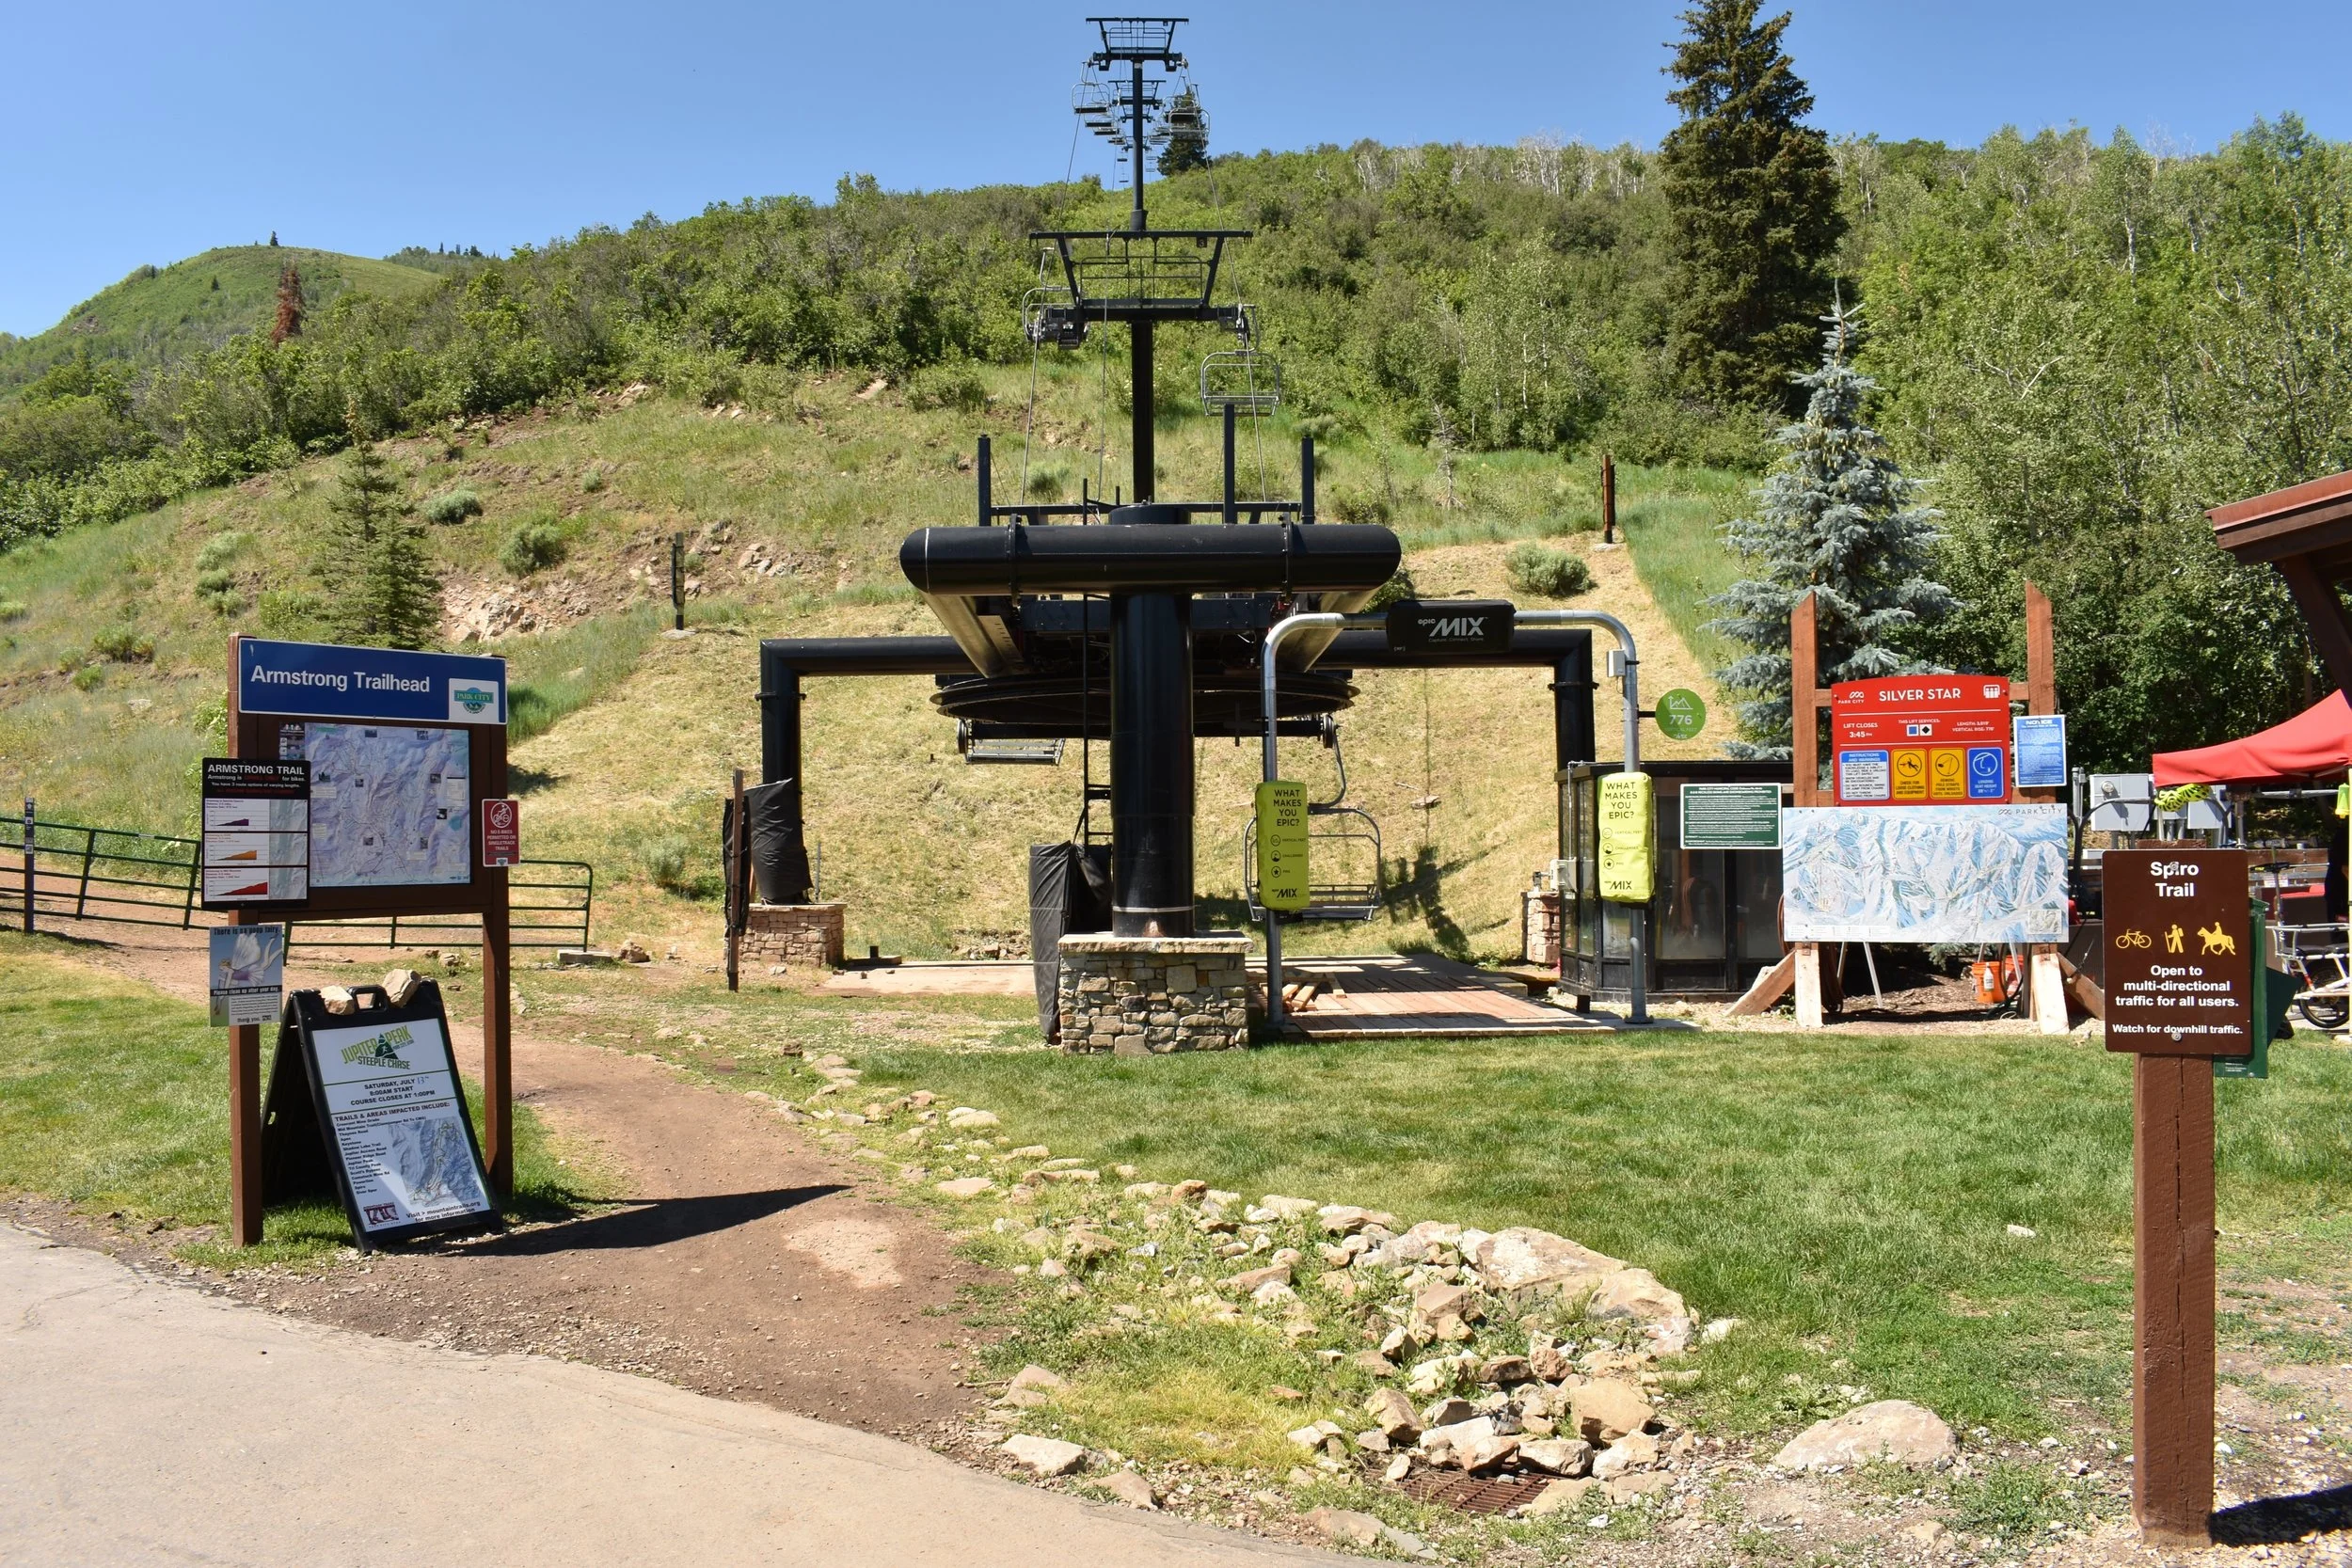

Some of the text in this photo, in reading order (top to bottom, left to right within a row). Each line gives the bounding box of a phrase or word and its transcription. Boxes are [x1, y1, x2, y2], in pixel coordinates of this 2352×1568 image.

[1429, 617, 1484, 637] MIX
[251, 665, 430, 692] Armstrong Trailhead
[1879, 688, 1961, 702] SILVER STAR
[1669, 715, 1692, 725] 776
[208, 765, 273, 774] ARMSTRONG
[1610, 880, 1632, 890] MIX
[2155, 882, 2194, 896] Trail
[1277, 888, 1297, 898] MIX
[2151, 965, 2202, 978] Open to
[2124, 980, 2230, 991] multi-directional
[2116, 996, 2239, 1006] traffic for all users.
[2112, 1024, 2243, 1034] Watch for downhill traffic.
[342, 1037, 377, 1064] JUPITER
[385, 1025, 412, 1044] PEAK
[358, 1056, 410, 1069] STEEPLE CHASE
[364, 1081, 399, 1089] SATURDAY,
[336, 1114, 358, 1122] TRAILS
[427, 1201, 481, 1214] mountaintrails.org
[441, 1208, 475, 1217] information
